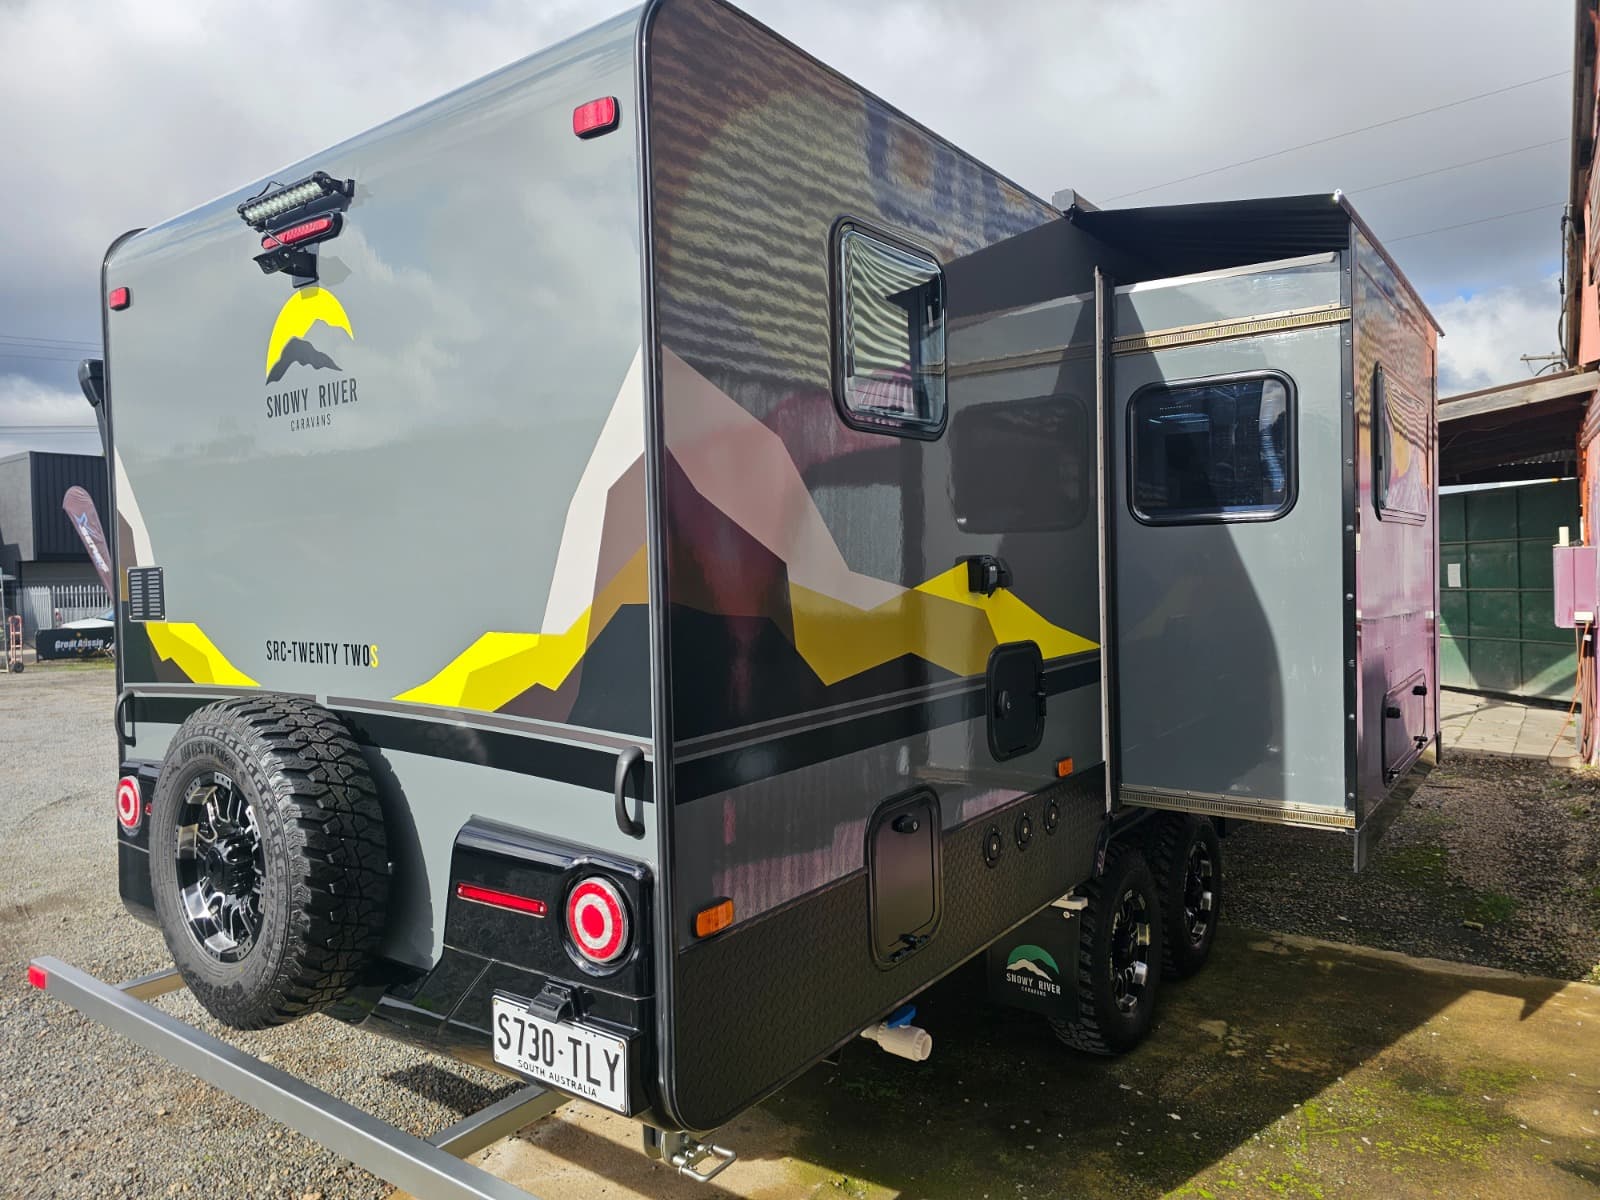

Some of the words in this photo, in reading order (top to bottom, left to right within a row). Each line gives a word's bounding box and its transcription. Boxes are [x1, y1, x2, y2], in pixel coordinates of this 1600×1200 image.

[266, 387, 308, 418] SNOWY
[318, 378, 358, 408] RIVER
[290, 413, 331, 432] CARAVANS
[266, 640, 338, 664] SRC-TWENTY
[343, 643, 379, 668] TWOS
[1006, 972, 1033, 987] SNOWY
[1038, 980, 1061, 995] RIVER
[517, 1059, 546, 1077] SOUTH
[549, 1071, 597, 1098] AUSTRALIA
